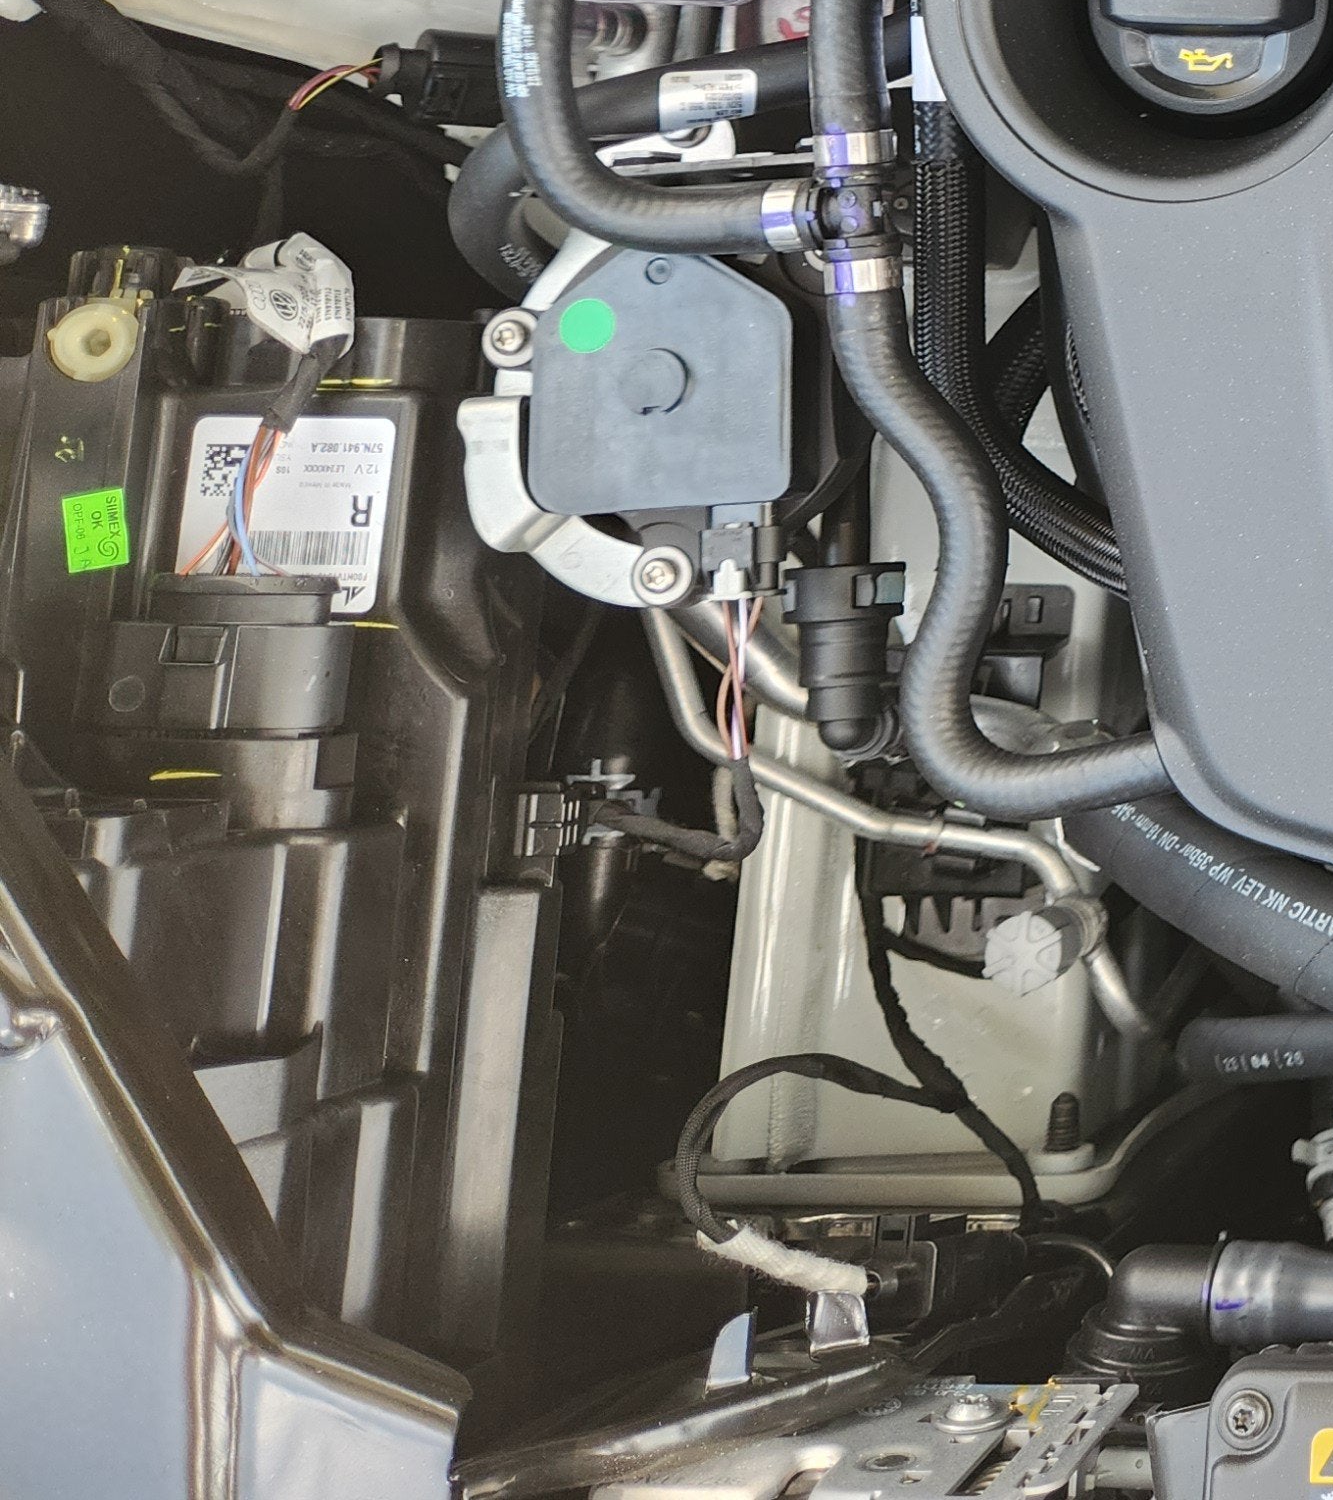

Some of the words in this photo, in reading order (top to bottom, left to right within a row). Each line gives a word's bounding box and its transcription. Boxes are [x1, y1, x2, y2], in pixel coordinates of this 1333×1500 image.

[91, 511, 104, 530] OK
[105, 496, 121, 539] SIIMEX
[350, 494, 374, 527] R
[1158, 831, 1179, 852] DN
[1179, 841, 1213, 871] 35bar
[1208, 861, 1234, 886] WP
[1262, 887, 1291, 913] NK
